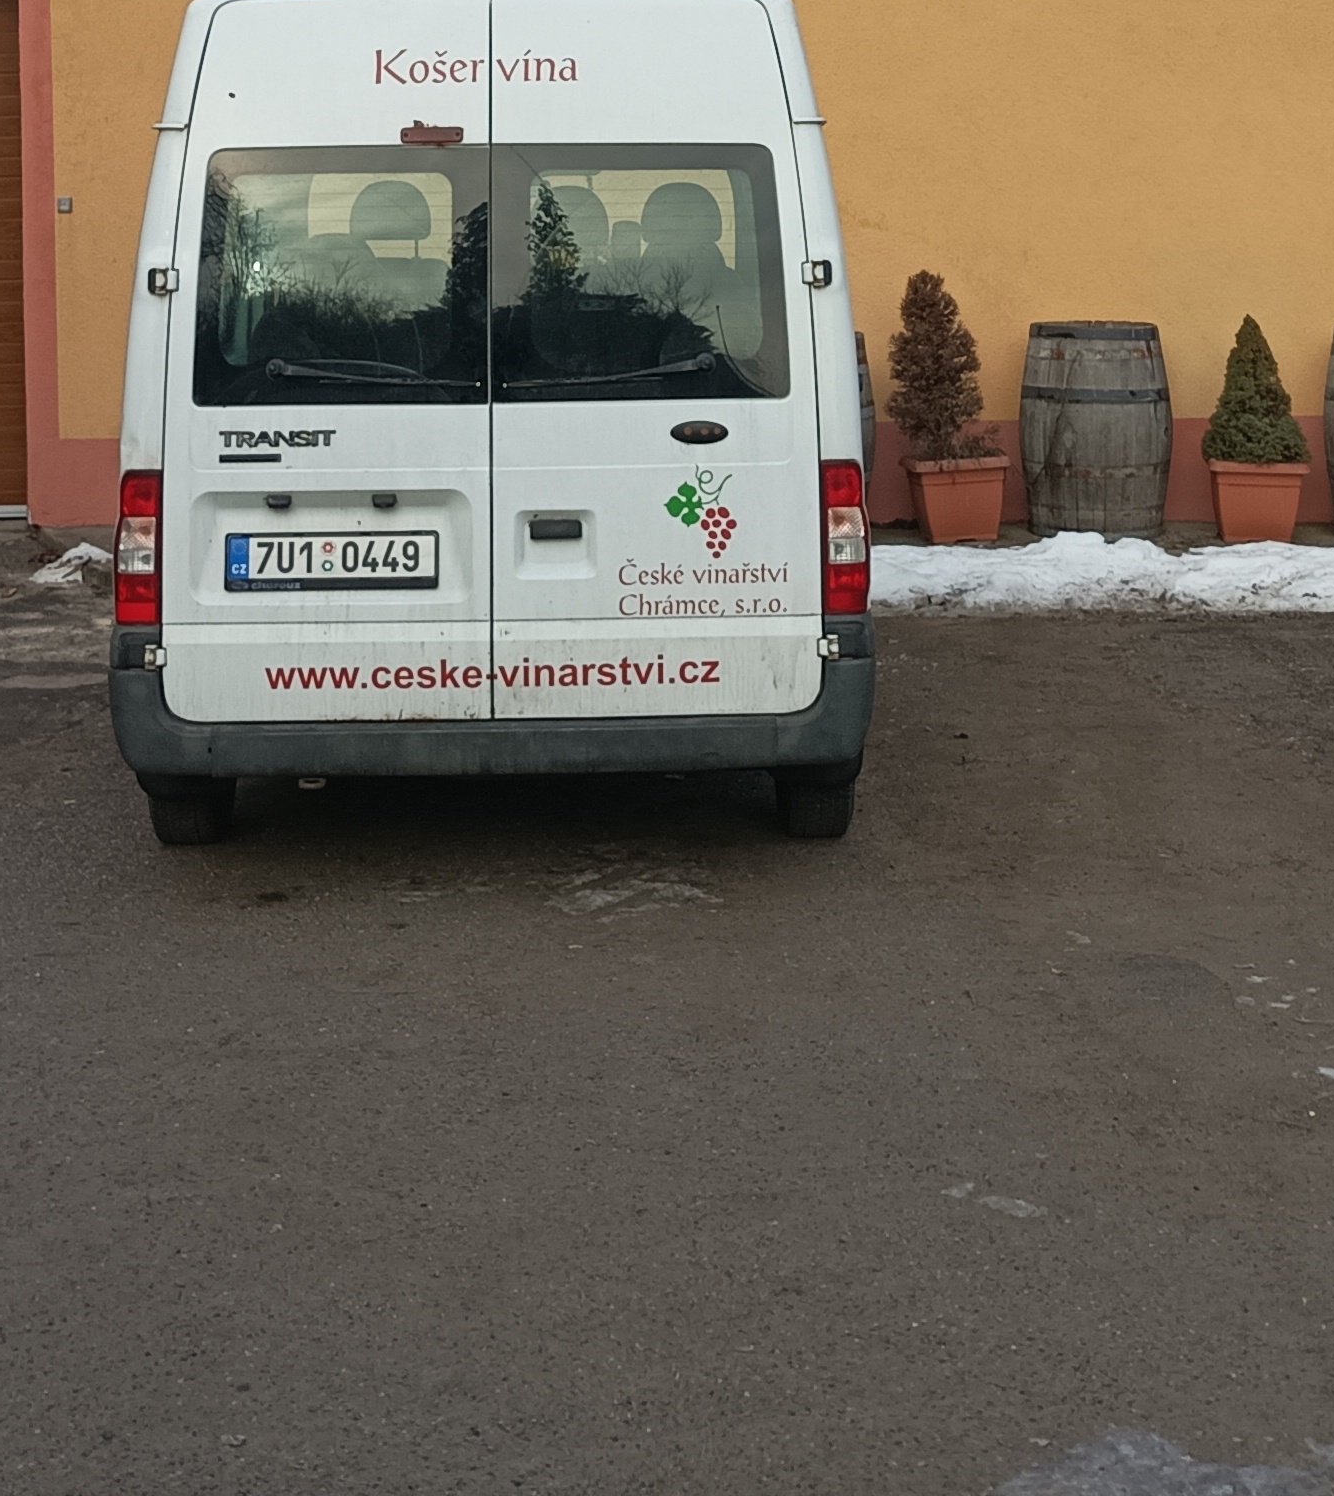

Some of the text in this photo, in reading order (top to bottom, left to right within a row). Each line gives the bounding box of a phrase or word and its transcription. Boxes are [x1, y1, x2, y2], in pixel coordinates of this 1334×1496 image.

[374, 48, 580, 85] Košer vína
[218, 429, 337, 448] TRANSIT
[231, 563, 247, 575] CZ
[618, 558, 789, 586] České vinařství
[618, 593, 788, 617] Chrámce, s.r.o.
[265, 654, 721, 690] www.ceske-vinarstvi.cz
